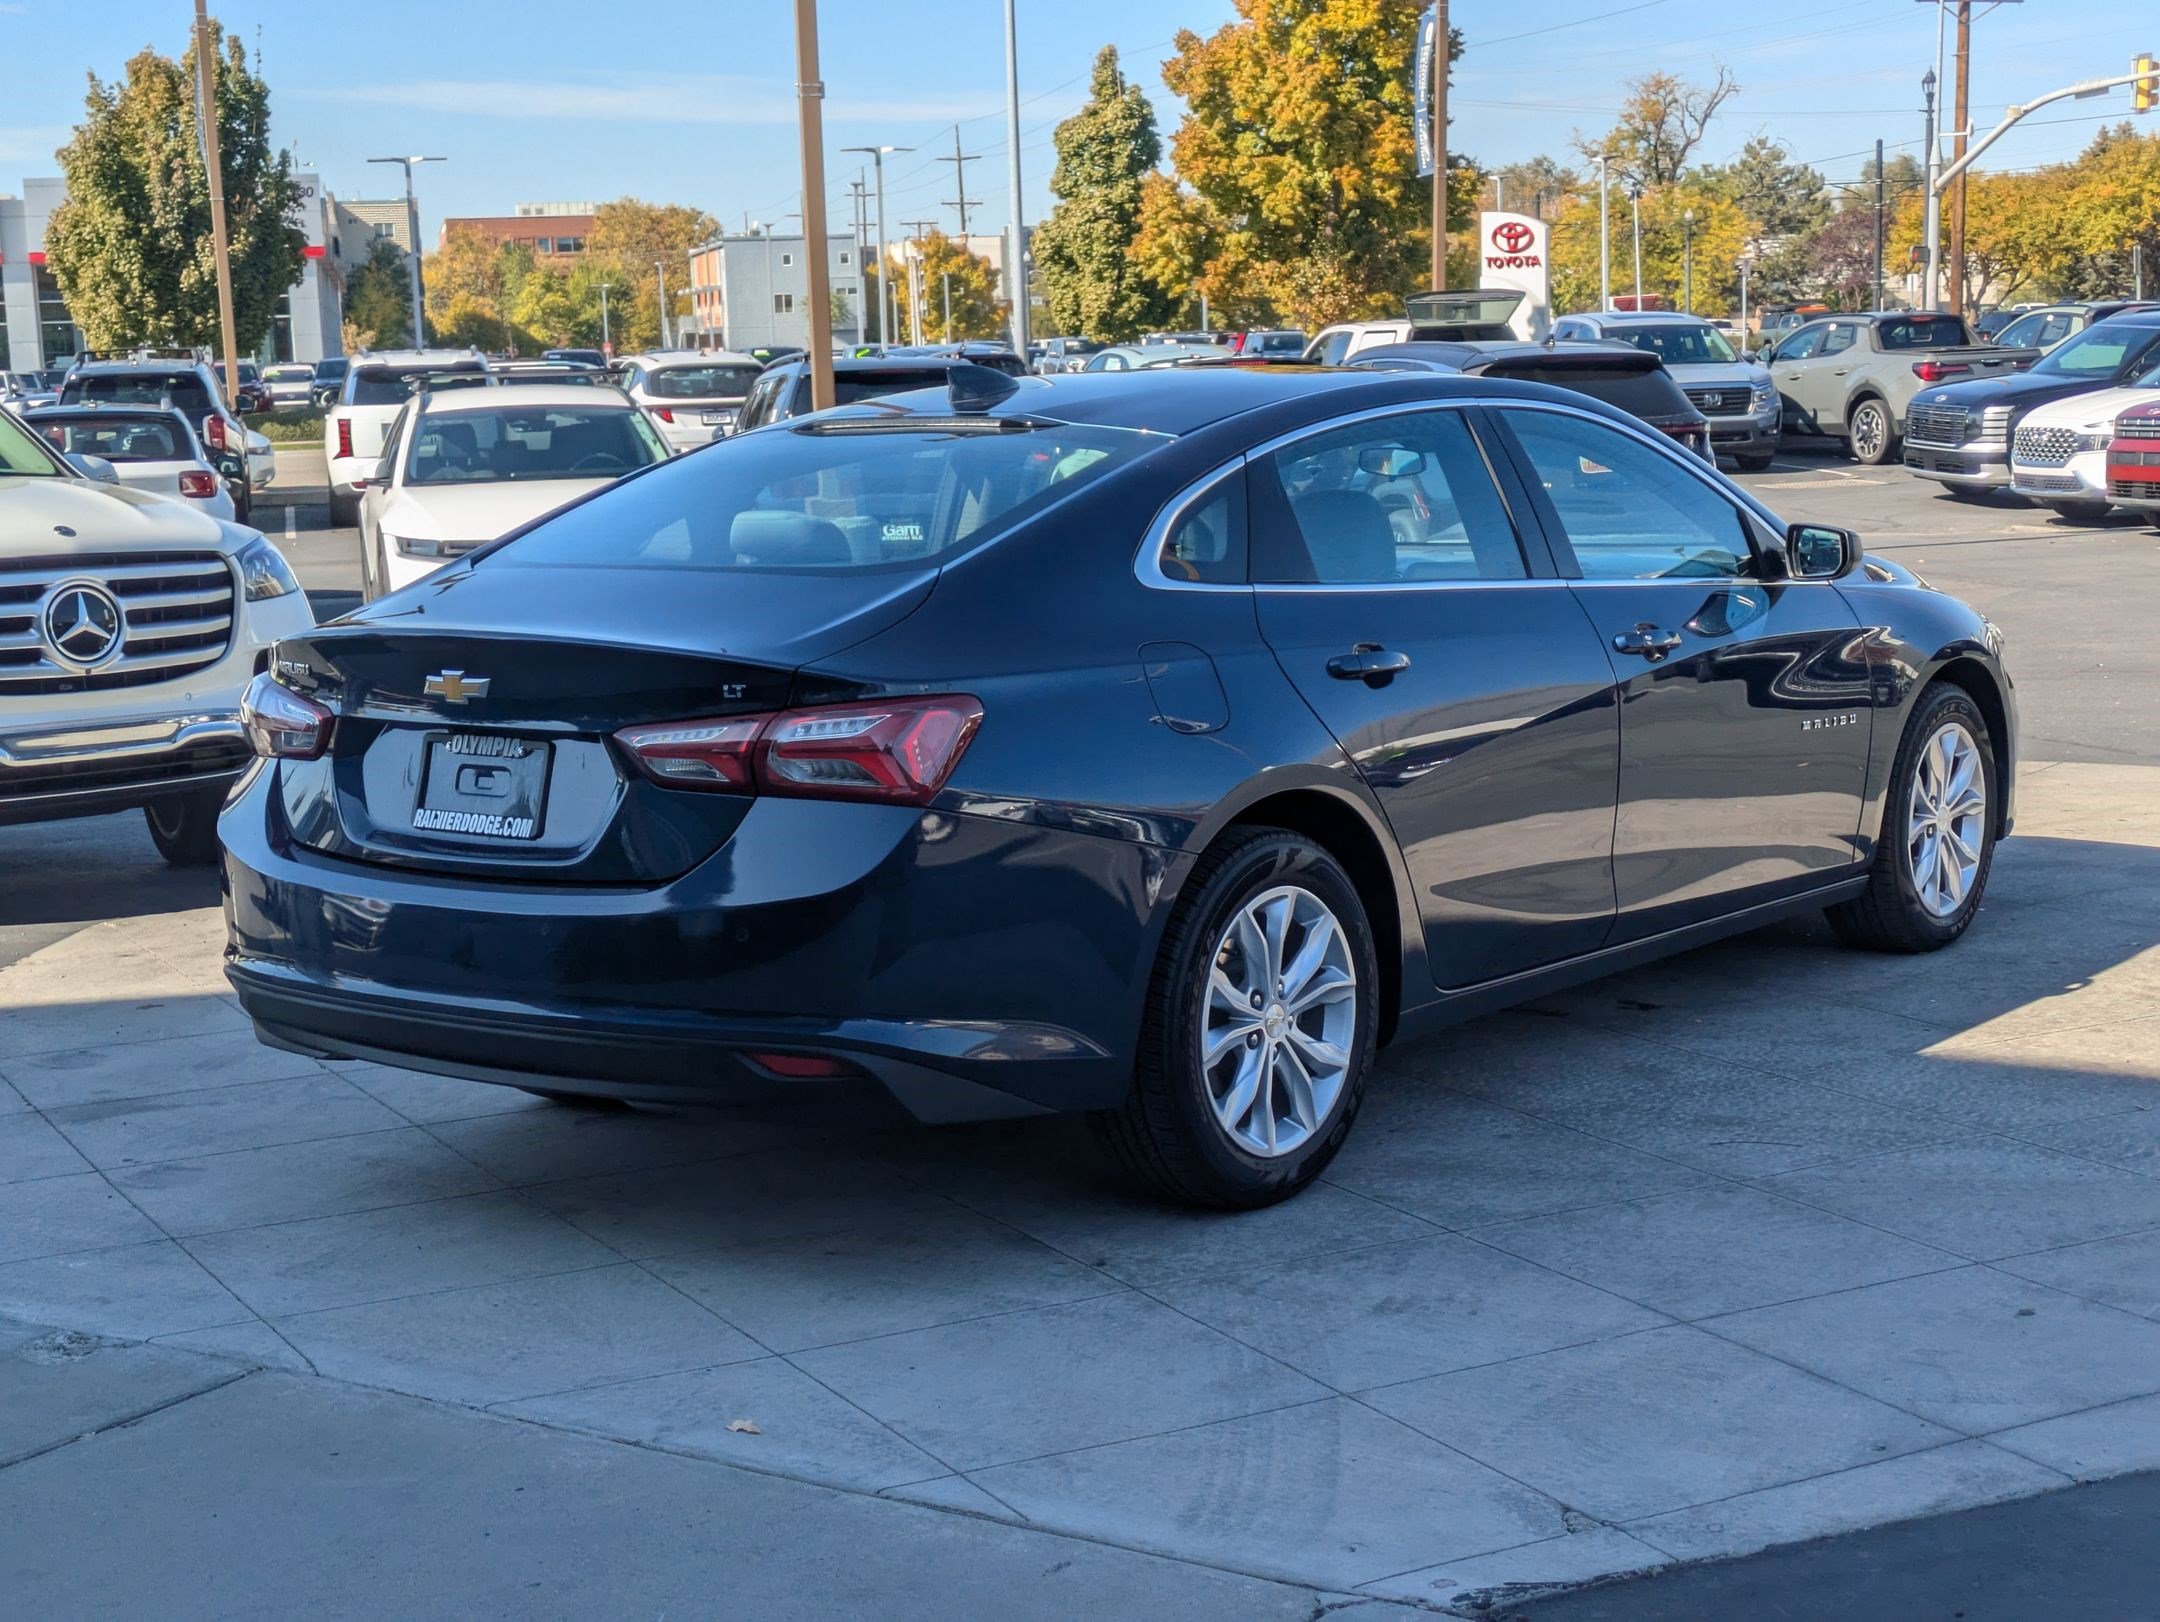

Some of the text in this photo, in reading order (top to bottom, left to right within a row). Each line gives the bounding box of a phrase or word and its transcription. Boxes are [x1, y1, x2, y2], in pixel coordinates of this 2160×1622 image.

[1485, 256, 1542, 269] TOYOTA
[722, 684, 747, 698] LT
[1801, 713, 1857, 731] MALIBU
[452, 735, 522, 758] OLYMPIA
[413, 808, 534, 838] RAINIERDODGE.COM
